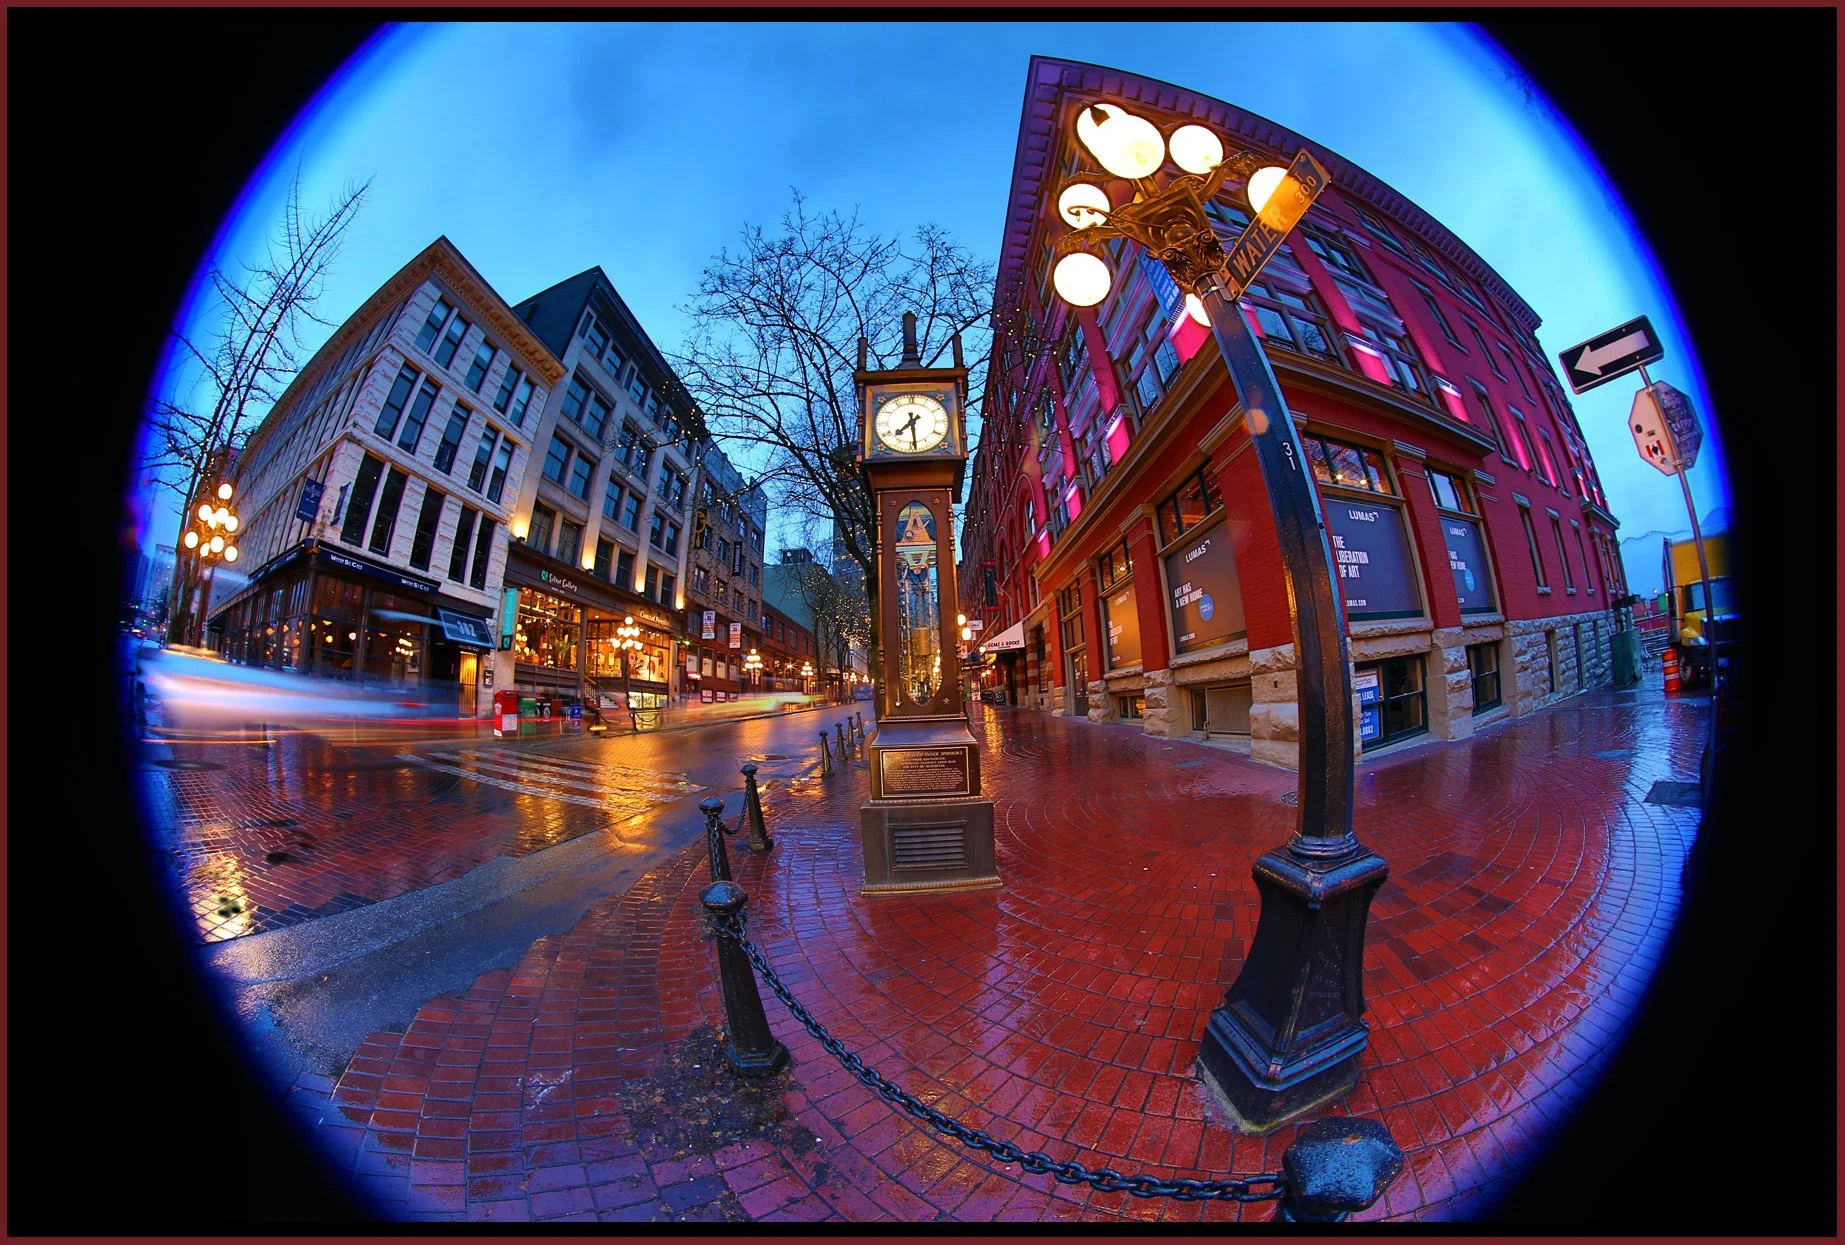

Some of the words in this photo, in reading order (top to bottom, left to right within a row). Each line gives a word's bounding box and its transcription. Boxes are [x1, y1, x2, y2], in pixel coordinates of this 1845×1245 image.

[1295, 175, 1317, 205] 300
[1232, 206, 1289, 278] WATER
[1282, 441, 1296, 471] 31
[1348, 509, 1376, 523] LUMAS
[1332, 535, 1346, 549] THE
[1185, 543, 1207, 564] LUMAS
[1335, 549, 1369, 564] LIBERATION
[1338, 564, 1347, 578] OF
[1348, 565, 1360, 578] ART
[1174, 586, 1183, 599] ART
[1182, 581, 1192, 595] HAS
[1178, 594, 1190, 607] NEW
[1190, 587, 1204, 603] HOME
[1362, 690, 1375, 701] LEASE
